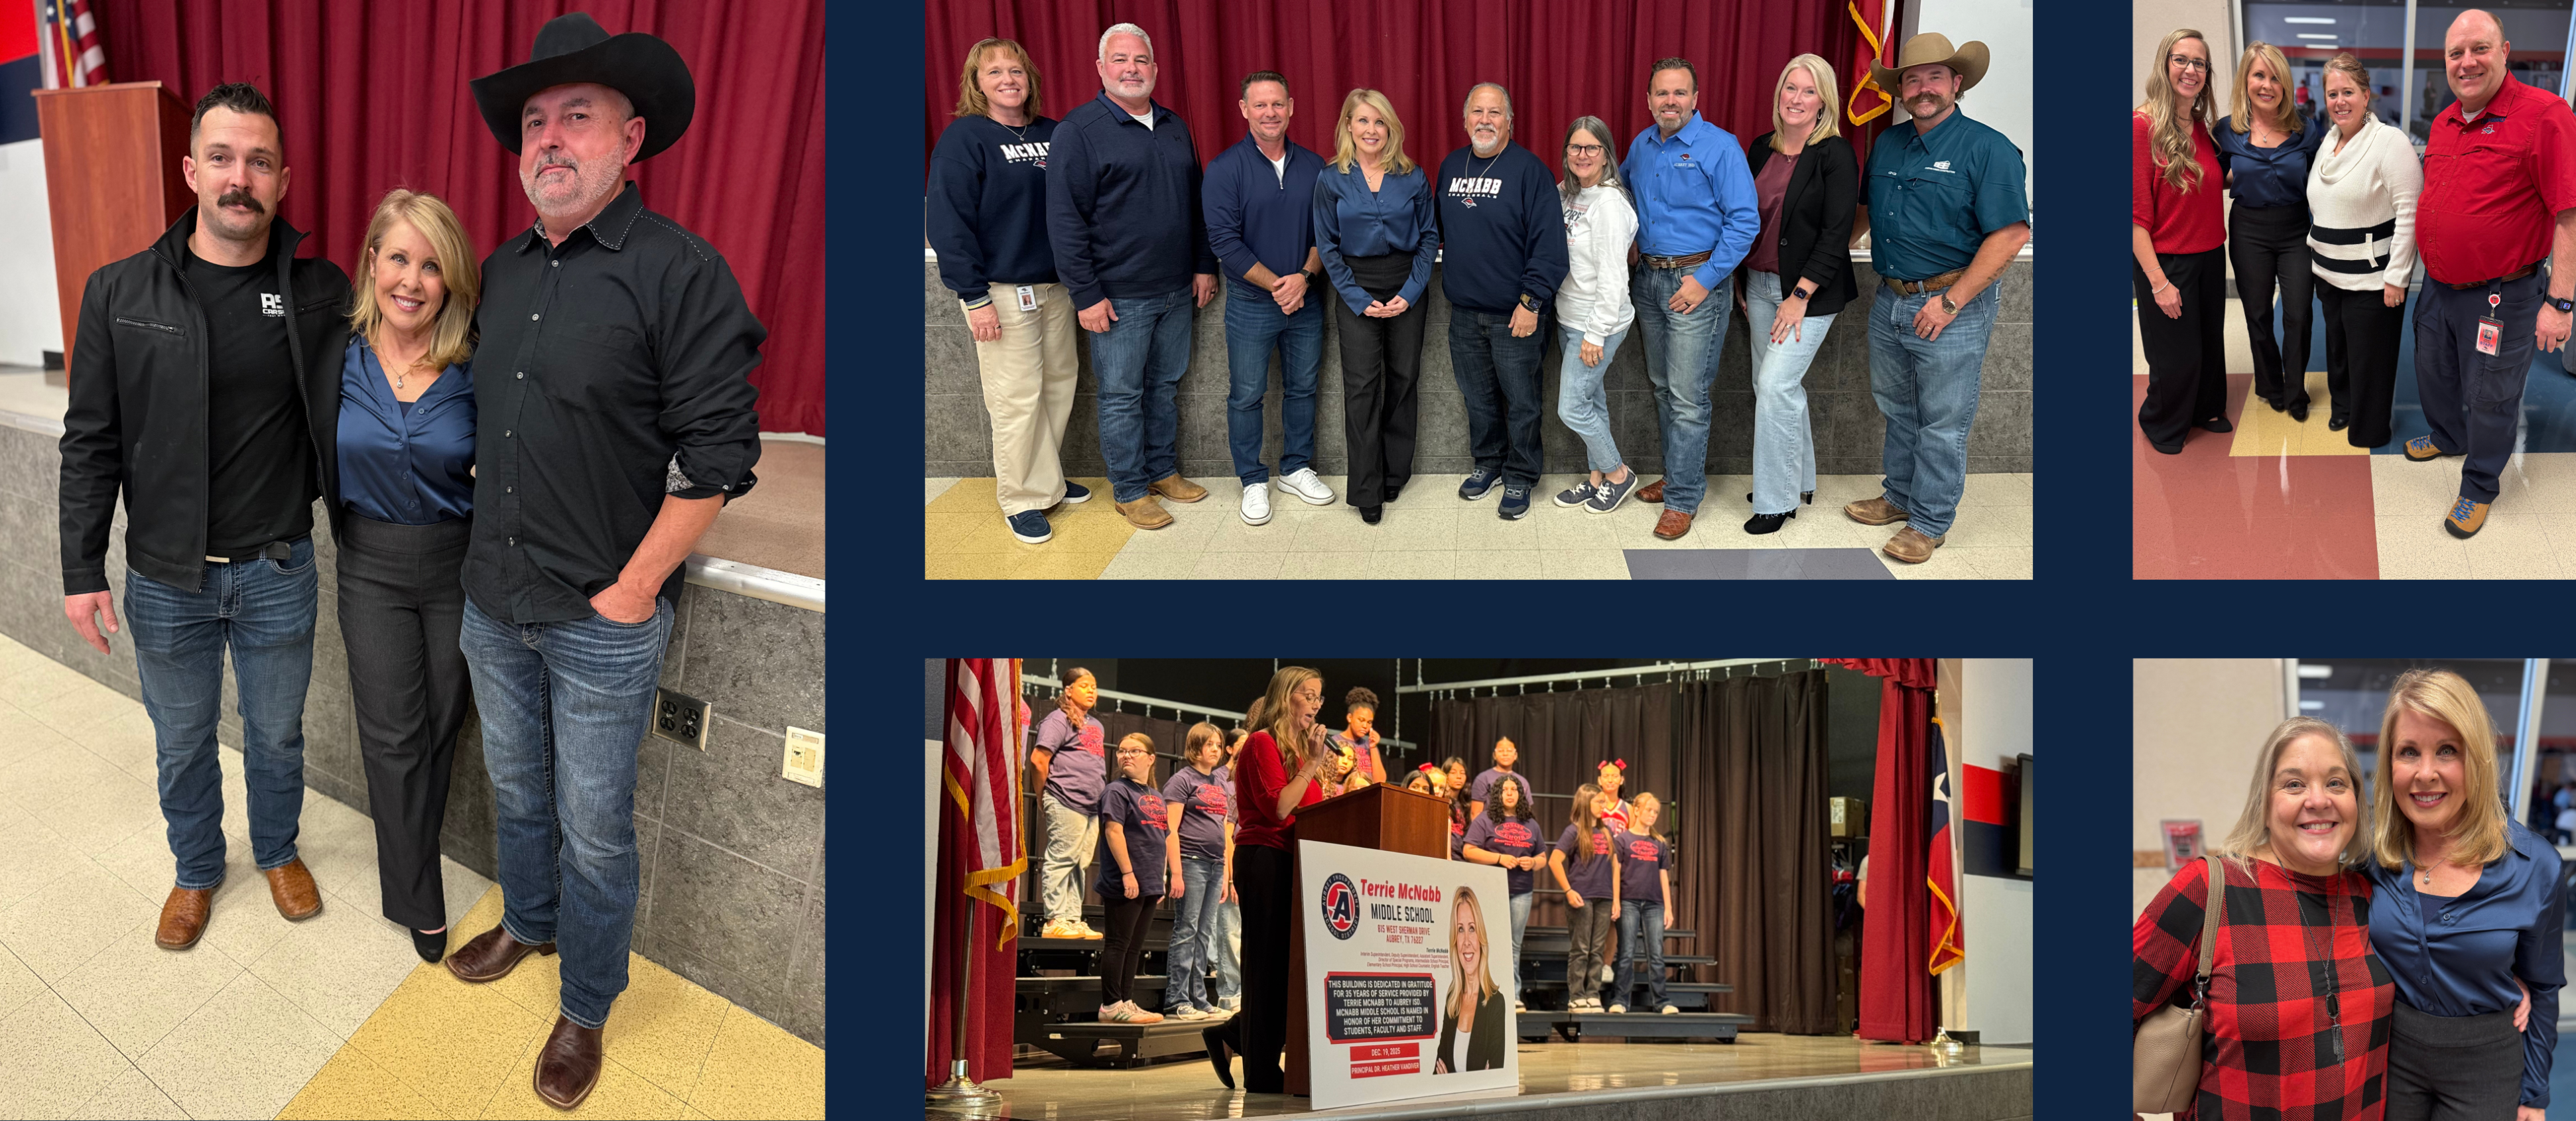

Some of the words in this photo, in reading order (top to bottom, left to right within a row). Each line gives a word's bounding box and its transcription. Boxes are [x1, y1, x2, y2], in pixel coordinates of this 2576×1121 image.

[1322, 878, 1332, 906] AUBREY
[1332, 874, 1359, 908] INDEPENDENT
[1360, 878, 1395, 898] Terrie
[1398, 882, 1441, 903] McNabb
[1371, 903, 1402, 921] MIDDLE
[1405, 906, 1435, 923] SCHOOL
[1324, 913, 1340, 939] SCHOOL
[1341, 915, 1358, 939] DISTRICT
[1386, 925, 1398, 934] WEST
[1399, 926, 1418, 935] SHERMAN
[1419, 927, 1431, 936] DRIVE
[1386, 934, 1404, 945] AUBREY,
[1411, 935, 1423, 945] 76227
[1382, 1016, 1415, 1024] COMMITMENT
[1344, 1026, 1373, 1035] STUDENTS,
[1351, 1065, 1374, 1075] PRINCIPAL
